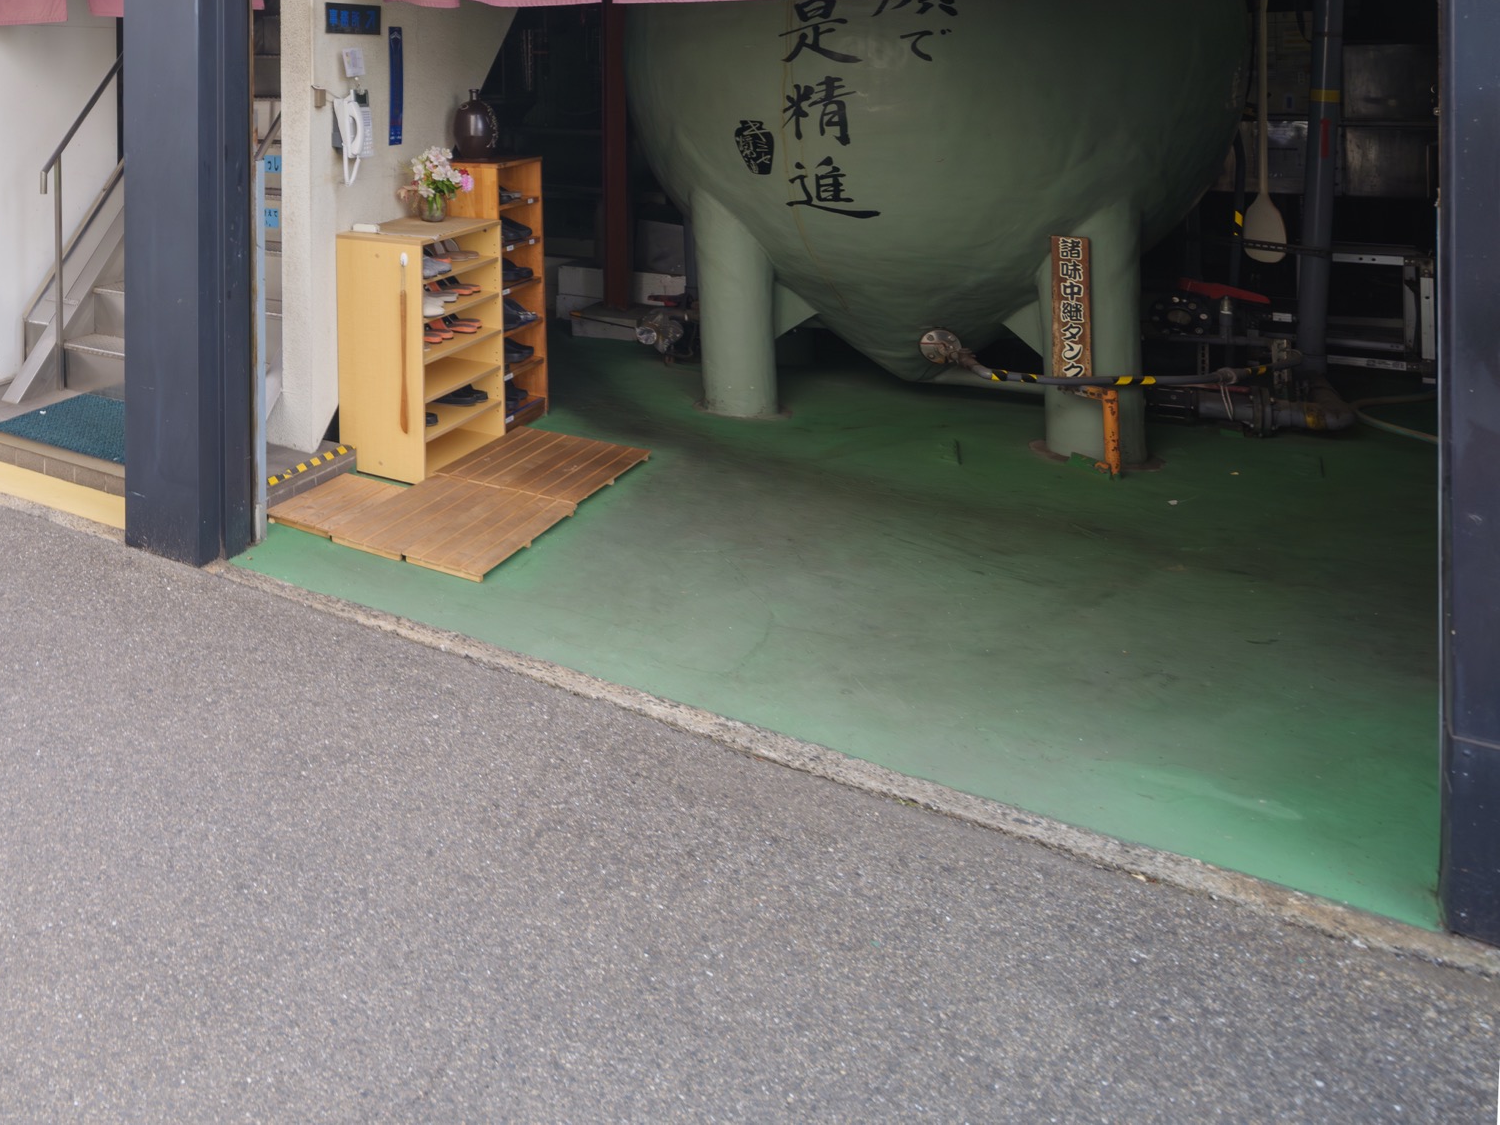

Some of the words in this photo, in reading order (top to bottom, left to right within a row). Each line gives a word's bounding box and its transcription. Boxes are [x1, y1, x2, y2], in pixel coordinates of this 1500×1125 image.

[328, 8, 360, 27] 事務所
[1059, 237, 1084, 377] 諸味中継タンク
